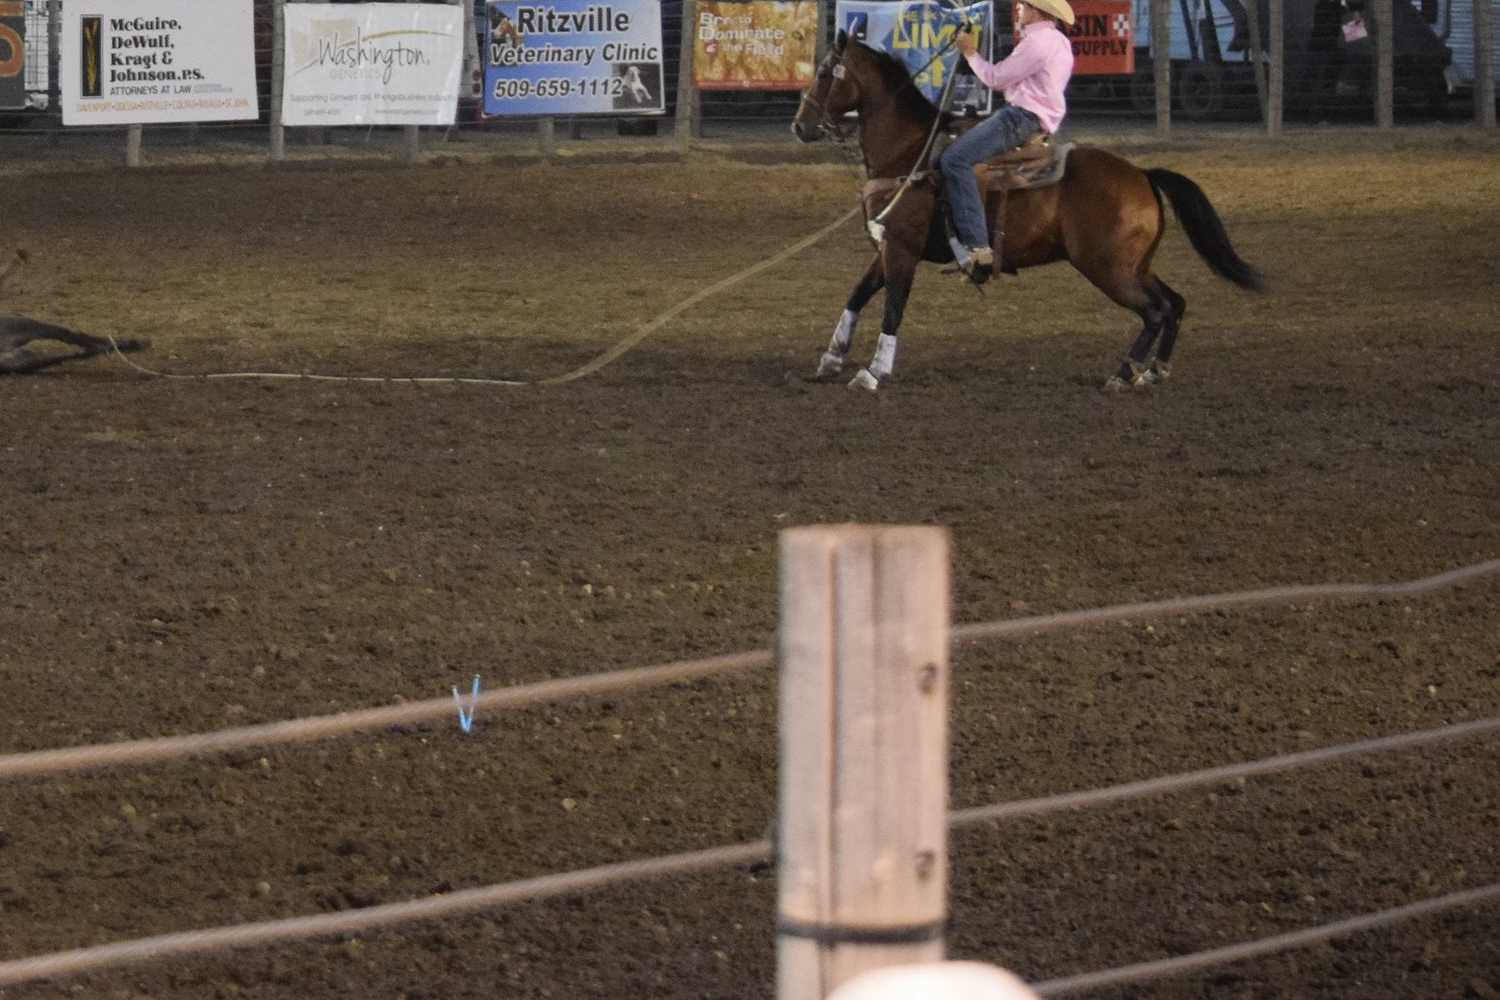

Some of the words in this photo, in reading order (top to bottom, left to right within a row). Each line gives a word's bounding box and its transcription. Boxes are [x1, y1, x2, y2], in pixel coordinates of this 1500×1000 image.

[518, 7, 630, 33] Ritzville
[700, 12, 738, 26] Bre
[699, 26, 785, 41] Dominate
[892, 22, 982, 51] LIMT
[319, 27, 425, 84] Washington
[492, 44, 595, 66] Veterinary
[602, 43, 658, 61] Clinic
[1073, 40, 1128, 56] SUPPLY
[110, 52, 158, 69] Kragt
[161, 51, 173, 64] &
[110, 85, 158, 97] ATTORNEYS
[160, 85, 170, 95] AT
[174, 84, 192, 95] LAW
[495, 78, 623, 97] 509-659-1112
